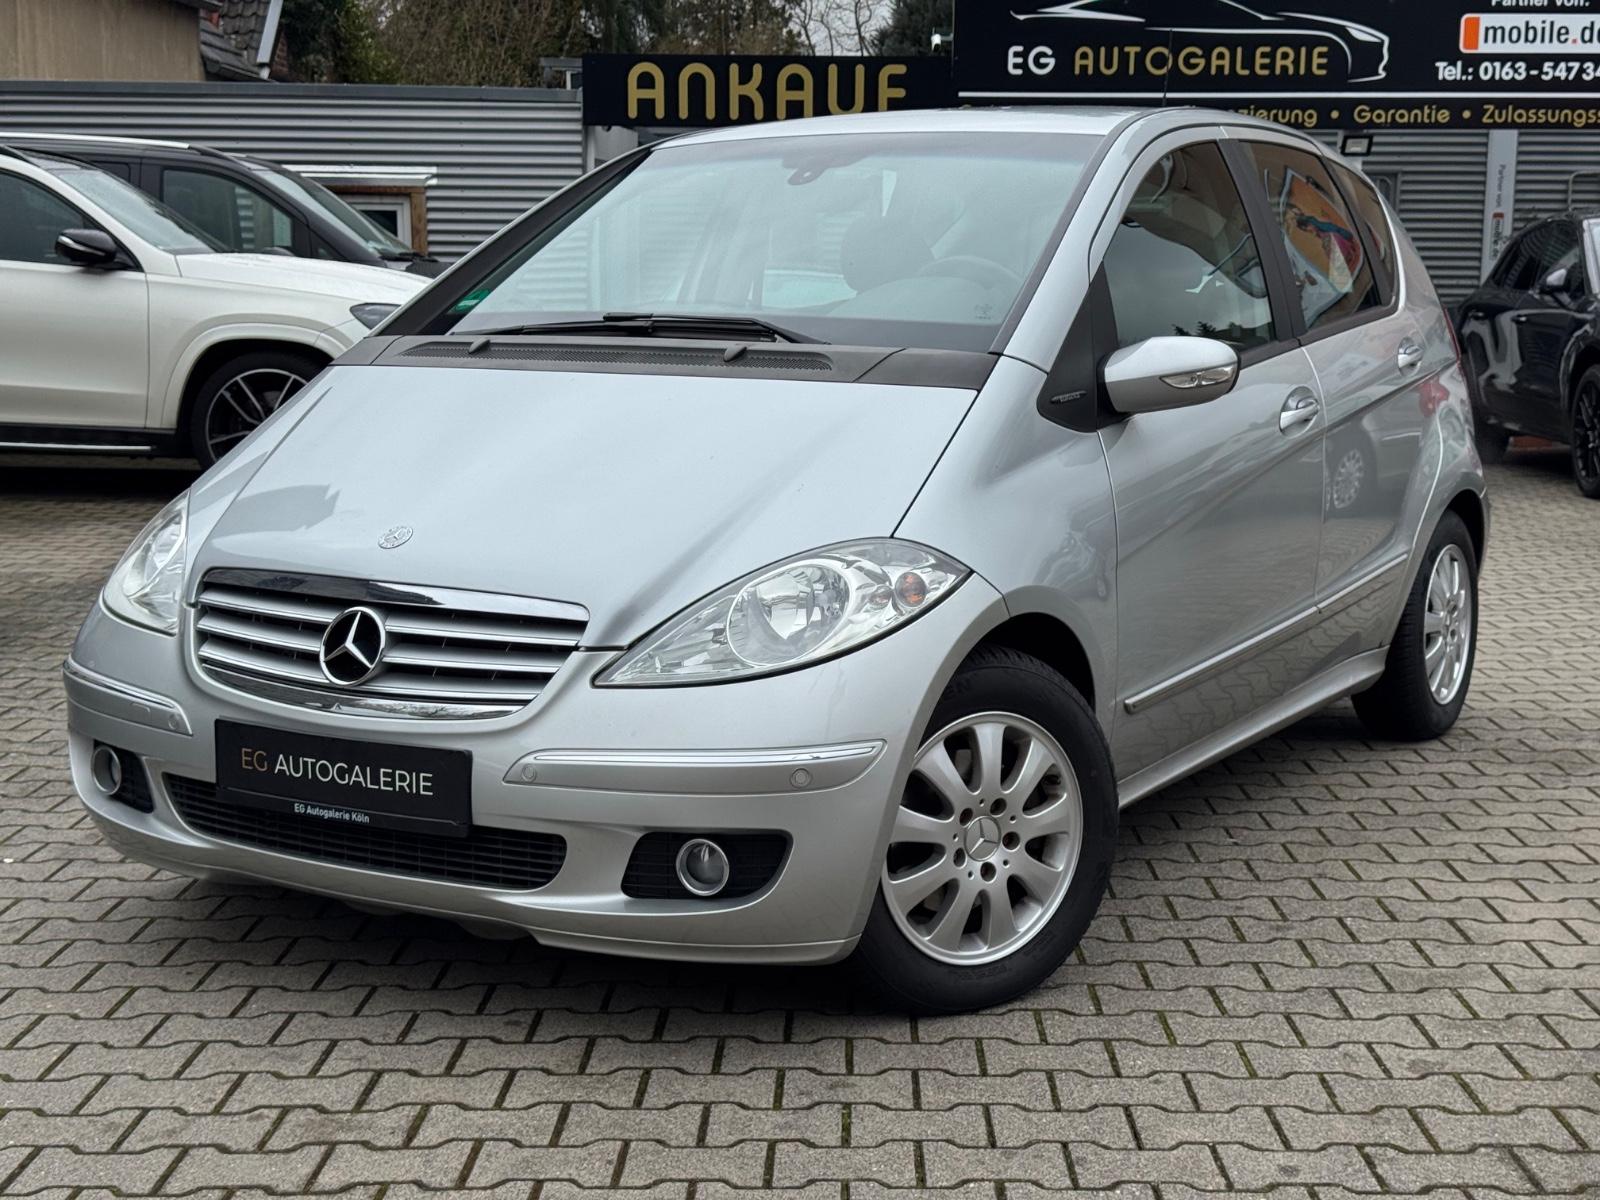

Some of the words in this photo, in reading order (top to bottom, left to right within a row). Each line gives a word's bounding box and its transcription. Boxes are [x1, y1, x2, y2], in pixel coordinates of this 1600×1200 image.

[1483, 19, 1600, 45] mobile.d
[1006, 45, 1056, 75] EG
[1073, 45, 1330, 76] AUTOGALERIE
[1434, 60, 1474, 81] Tel.:
[626, 61, 908, 121] ANKAUF
[1353, 104, 1451, 124] Garantie
[241, 747, 268, 772] EG
[274, 753, 434, 796] AUTOGALERIE
[294, 803, 306, 813] EG
[306, 805, 351, 820] Autogalerie
[351, 811, 370, 824] Köln
